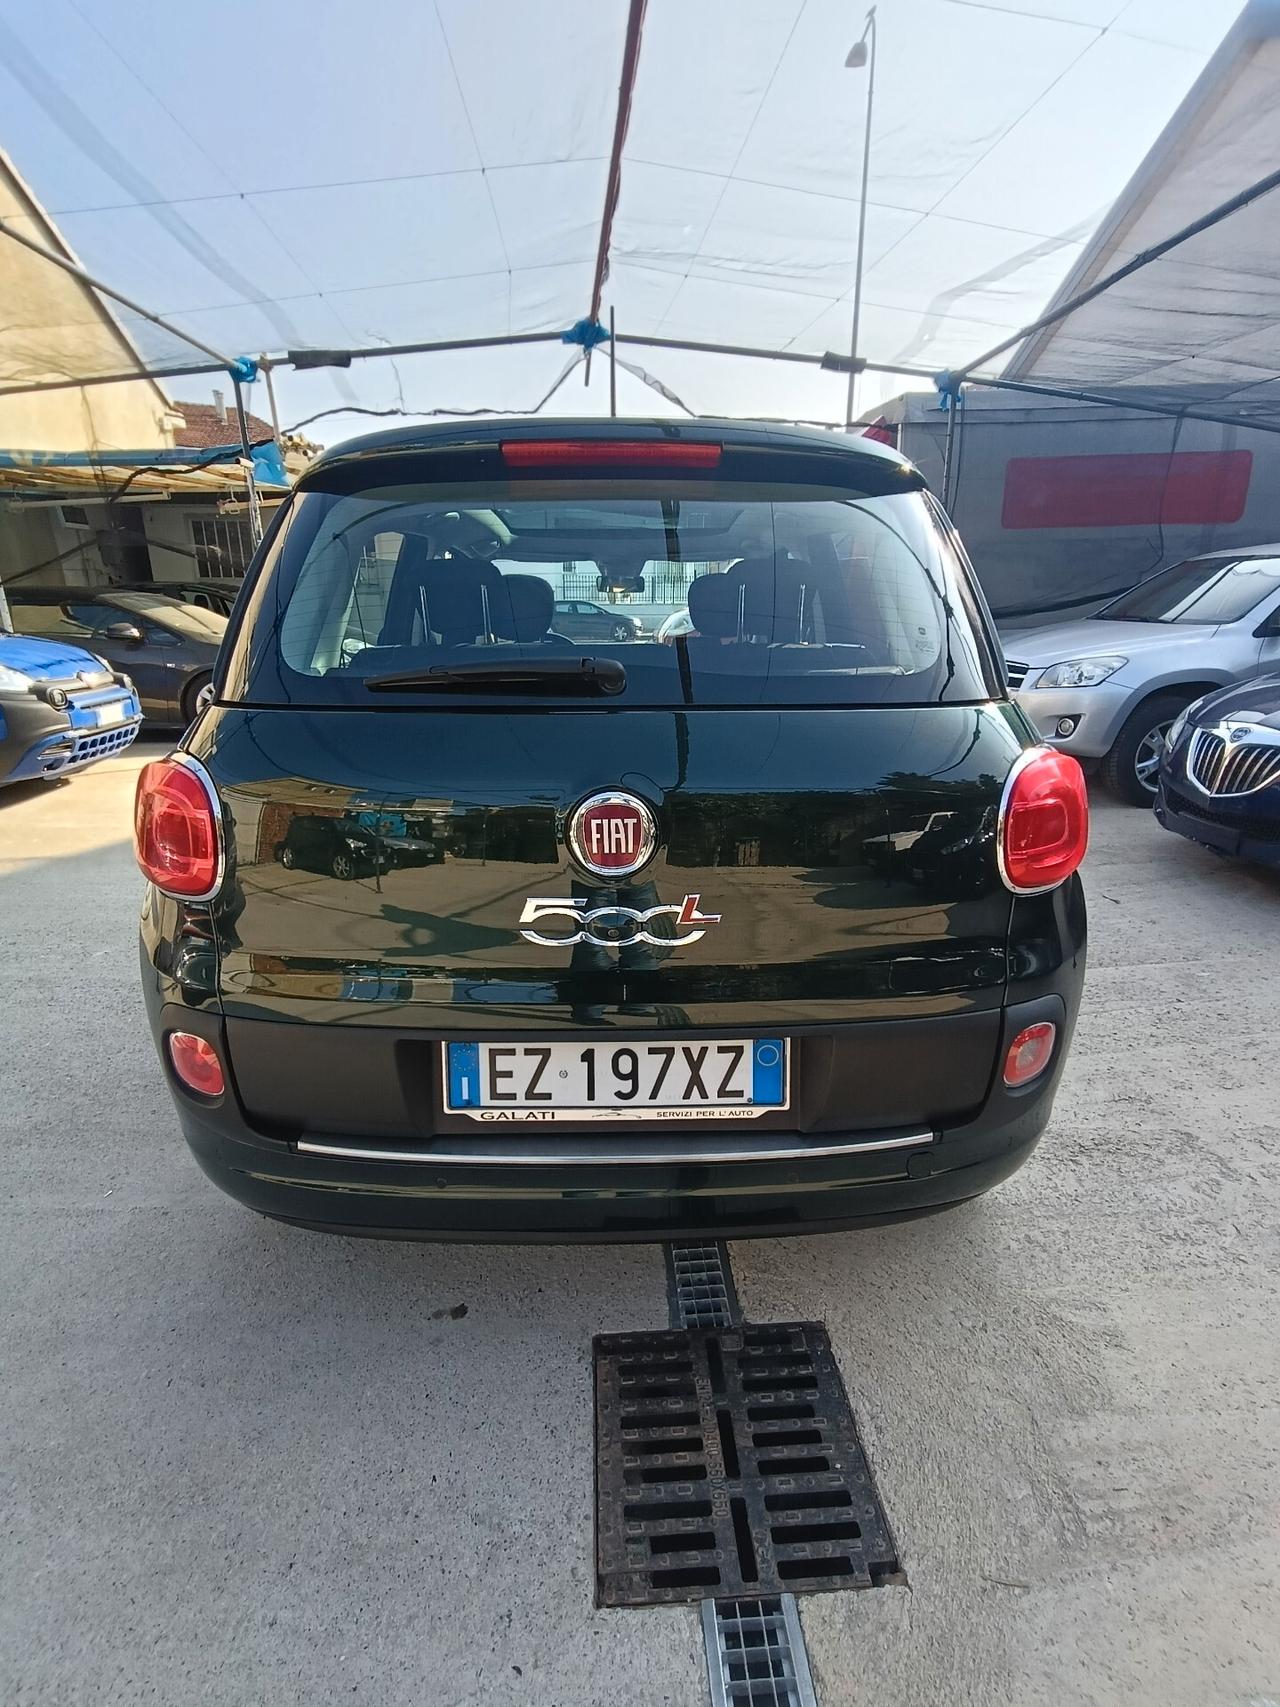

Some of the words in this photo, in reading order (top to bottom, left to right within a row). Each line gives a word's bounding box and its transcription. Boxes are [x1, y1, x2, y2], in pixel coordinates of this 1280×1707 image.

[591, 819, 637, 853] FIAT
[519, 894, 722, 947] 500L
[480, 1111, 556, 1121] GALATI
[656, 1110, 693, 1118] SERVIZI
[708, 1462, 729, 1518] 550X550
